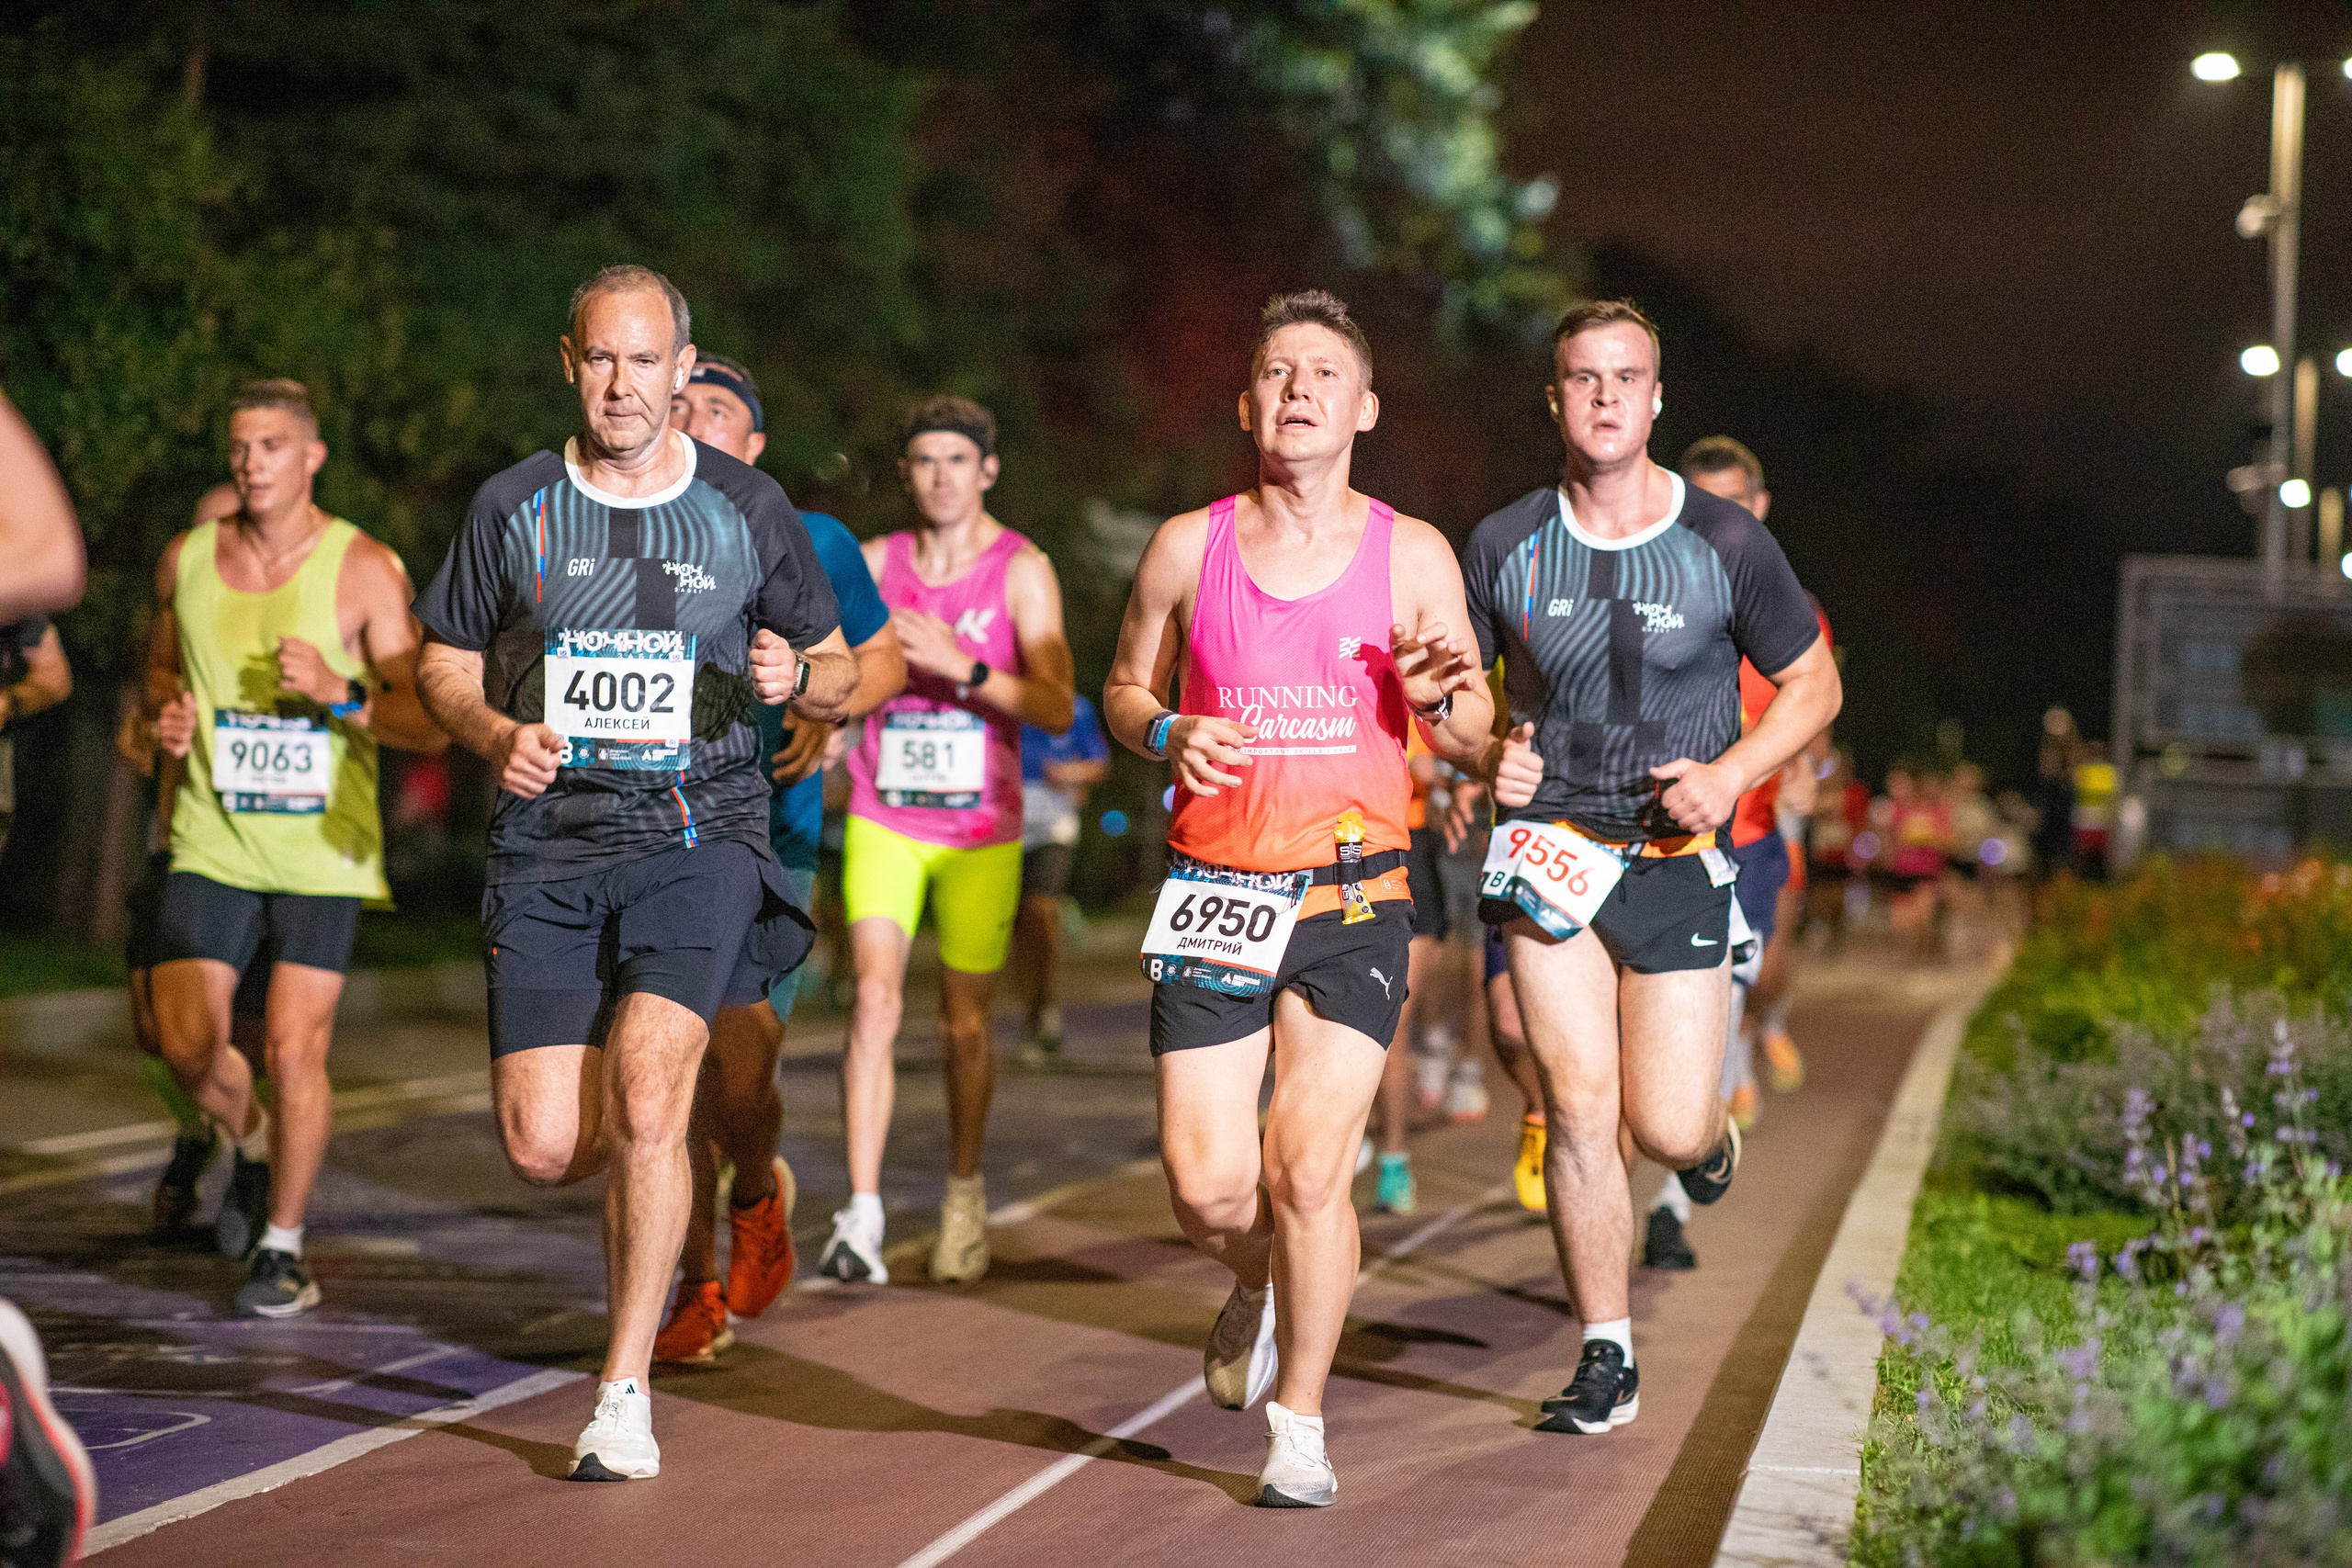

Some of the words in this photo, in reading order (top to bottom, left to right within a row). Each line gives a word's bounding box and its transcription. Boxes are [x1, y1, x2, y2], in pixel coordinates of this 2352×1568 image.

[567, 558, 595, 577] GRi
[1548, 599, 1574, 616] GRi
[564, 671, 675, 713] 4002
[1217, 685, 1358, 709] RUNNING
[584, 716, 650, 730] АЛЕКСЕЙ
[232, 740, 311, 773] 9063
[903, 741, 954, 769] 581
[1509, 829, 1595, 897] 9556
[1170, 894, 1277, 942] 6950
[1177, 937, 1243, 955] ДМИТРИЙ
